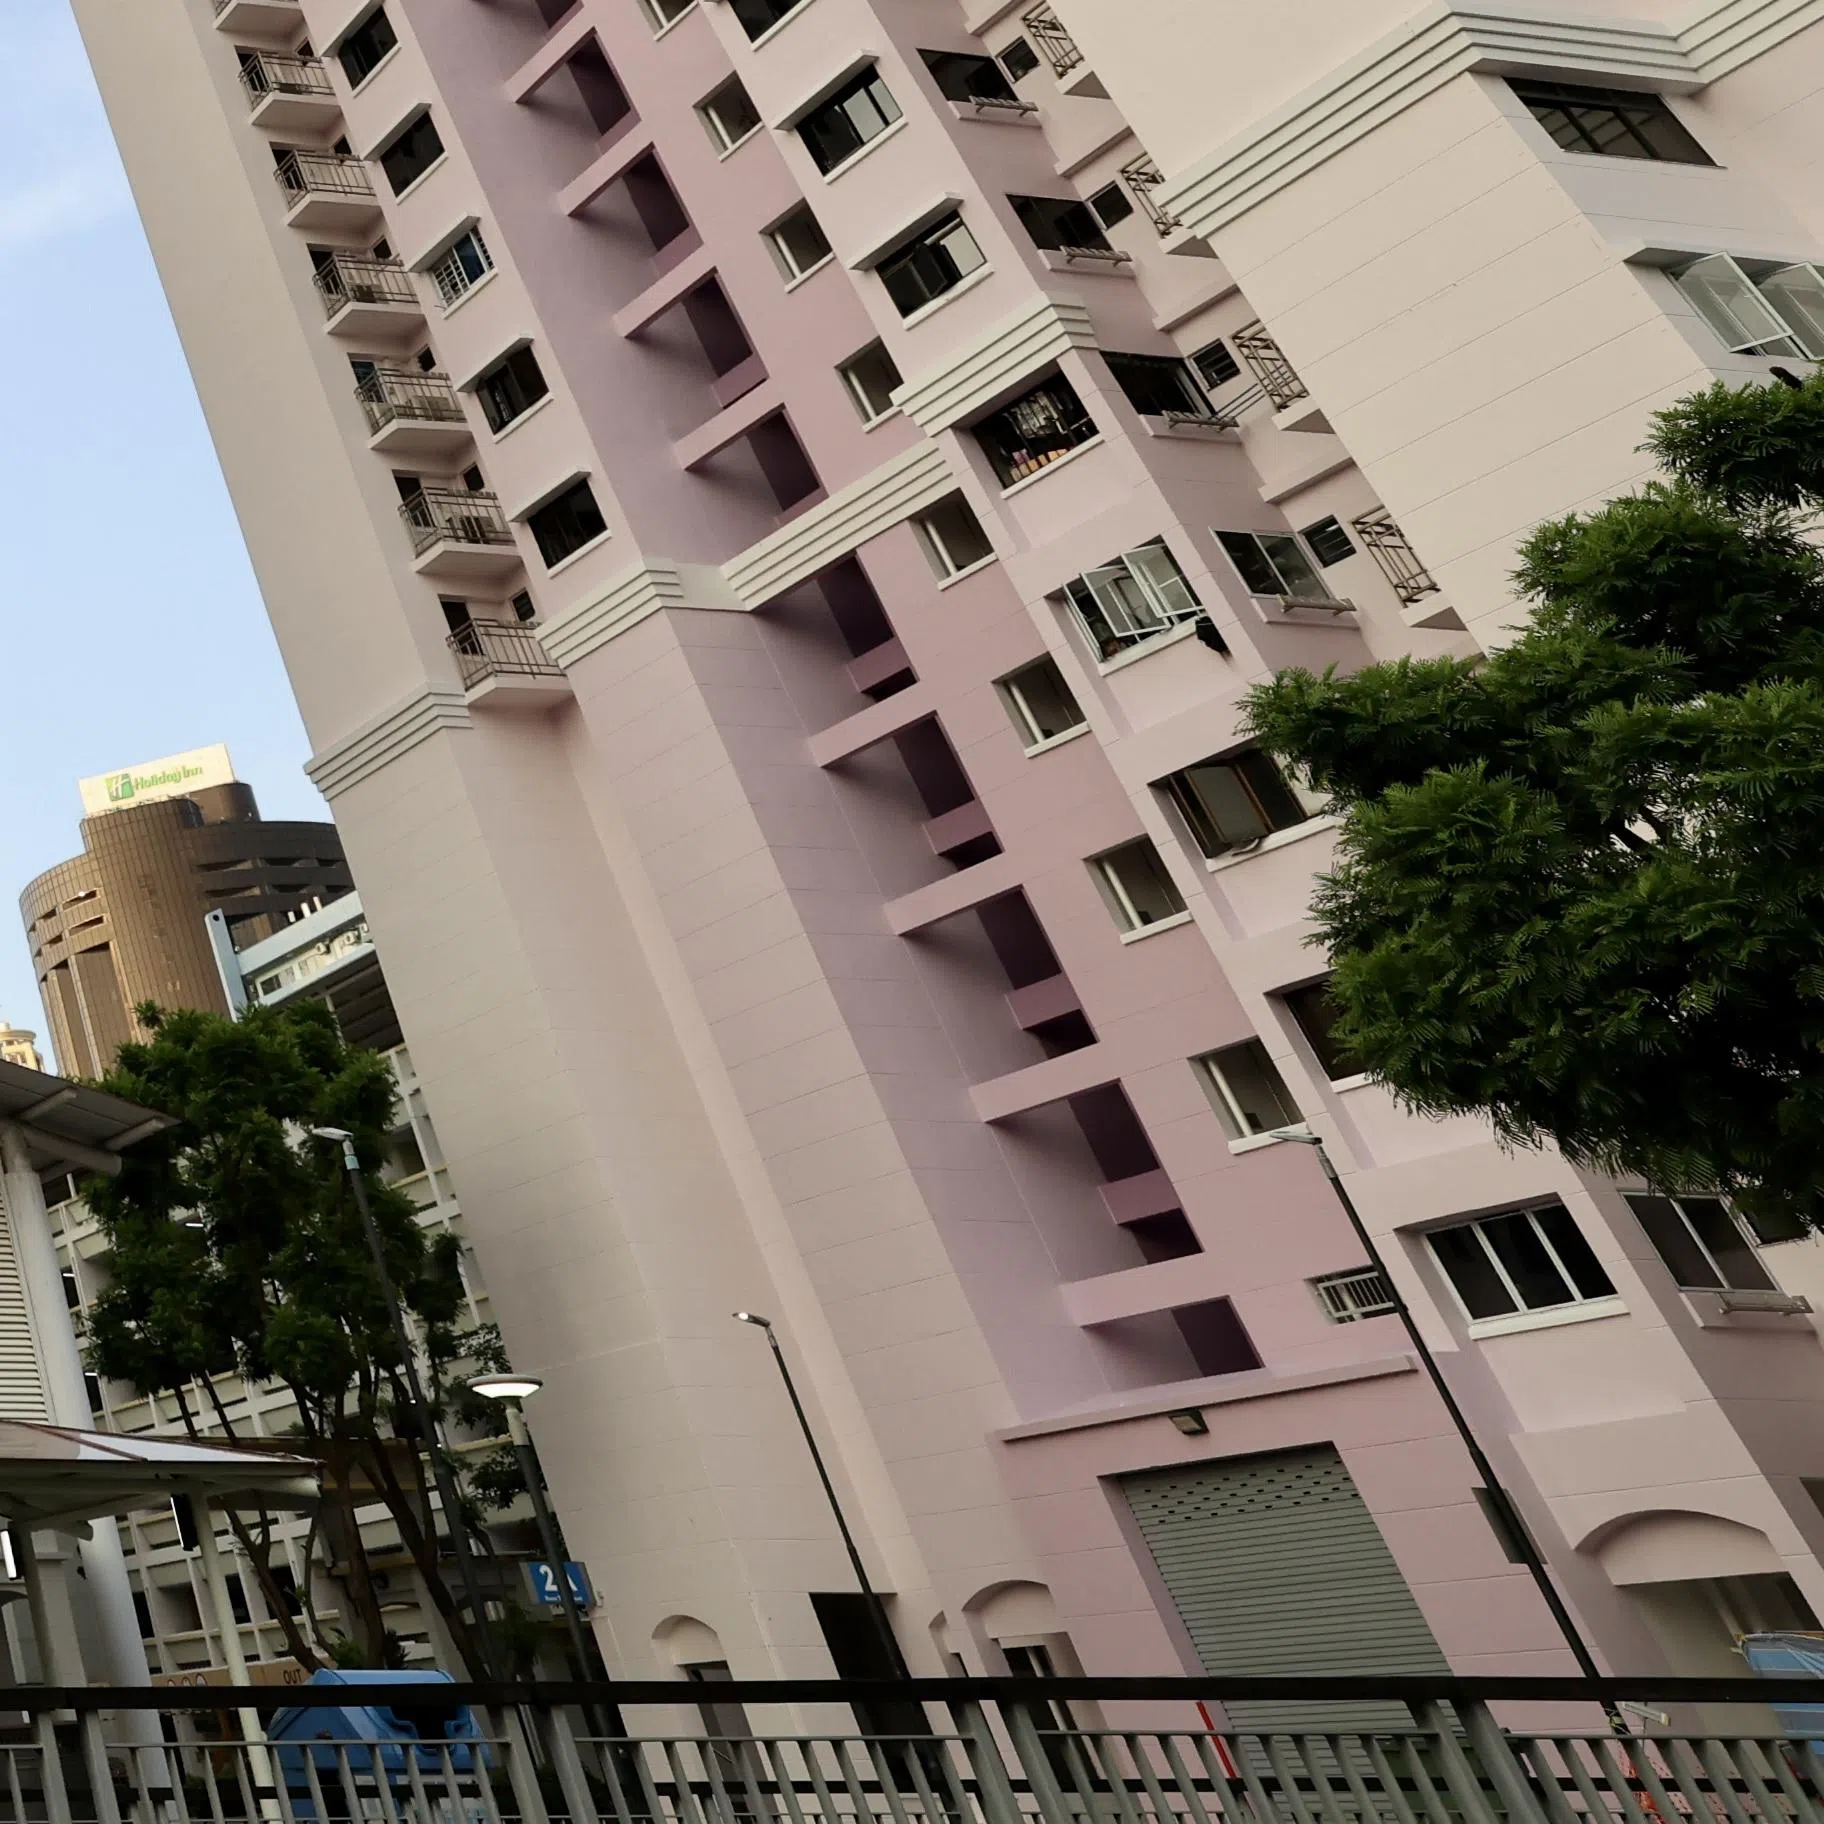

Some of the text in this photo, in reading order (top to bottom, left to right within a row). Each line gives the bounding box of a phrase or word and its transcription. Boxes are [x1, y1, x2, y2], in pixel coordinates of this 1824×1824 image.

[134, 765, 203, 791] Holiday Inn
[282, 1668, 302, 1685] OUT
